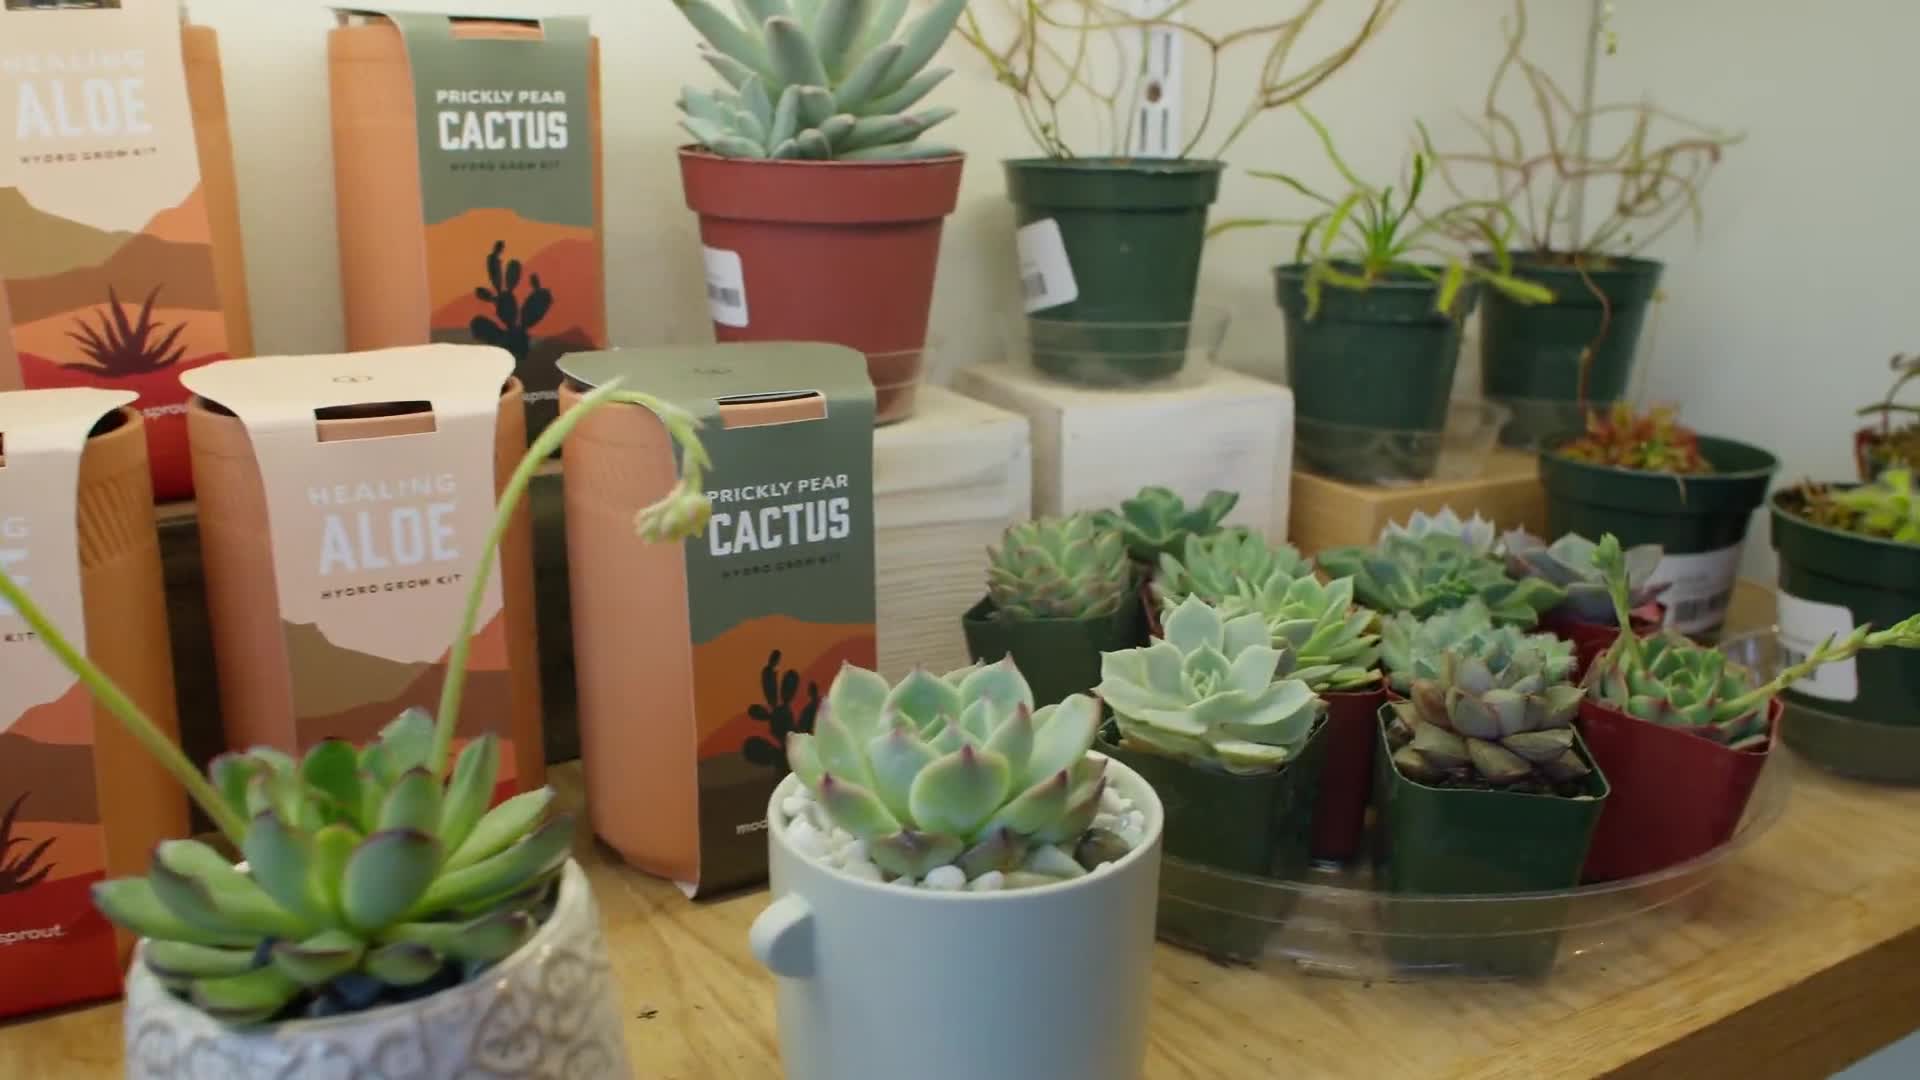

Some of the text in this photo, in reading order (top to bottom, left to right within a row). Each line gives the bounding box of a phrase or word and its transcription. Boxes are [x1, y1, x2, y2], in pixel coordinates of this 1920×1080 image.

[16, 77, 152, 140] ALOE
[436, 89, 566, 104] PRICKLY PEAR
[438, 110, 568, 150] CACTUS
[308, 473, 456, 505] HEALING
[707, 474, 848, 503] PRICKLY PEAR
[318, 502, 461, 577] ALOE
[709, 497, 850, 556] CACTUS
[320, 573, 463, 600] HYDRO GROW KIT
